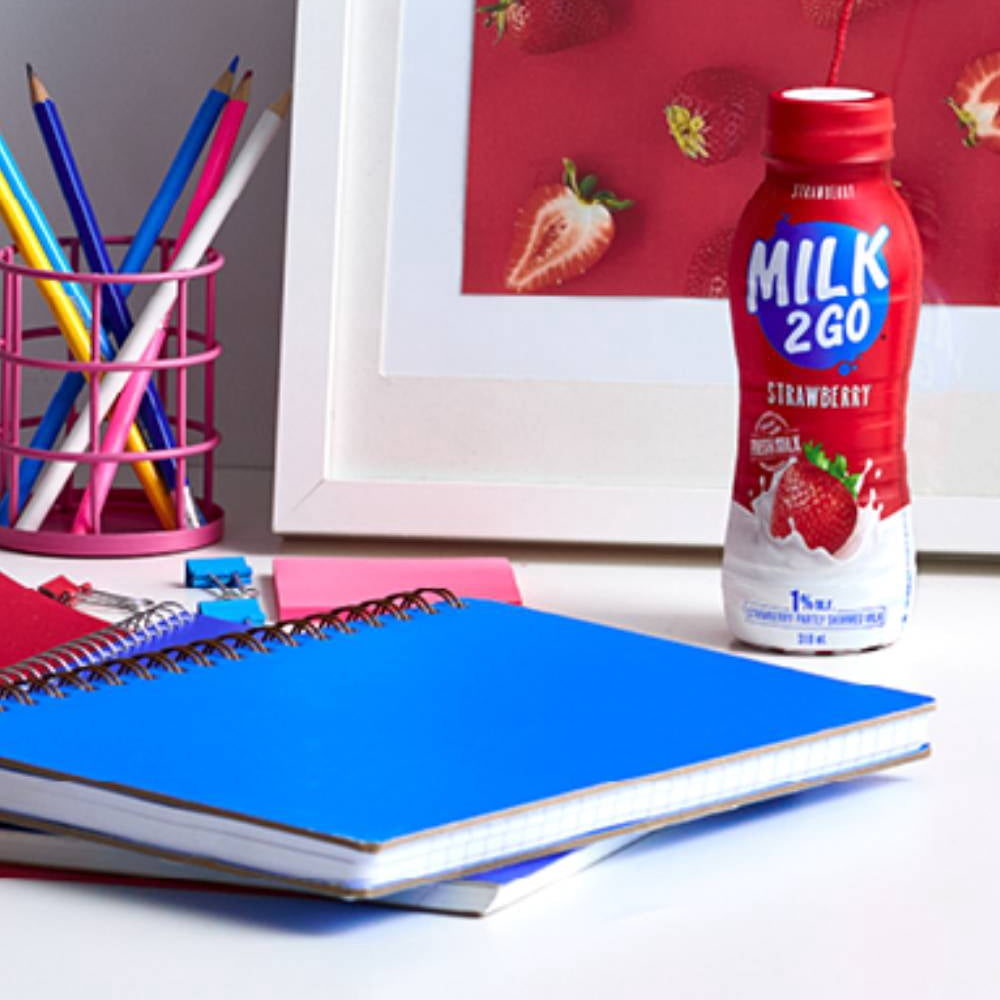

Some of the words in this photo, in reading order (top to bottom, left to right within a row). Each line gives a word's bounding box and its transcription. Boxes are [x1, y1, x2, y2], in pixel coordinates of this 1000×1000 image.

[746, 224, 891, 314] MILK
[784, 298, 871, 355] 2GO
[767, 381, 872, 408] STRAWBERRY
[790, 589, 813, 613] 1%
